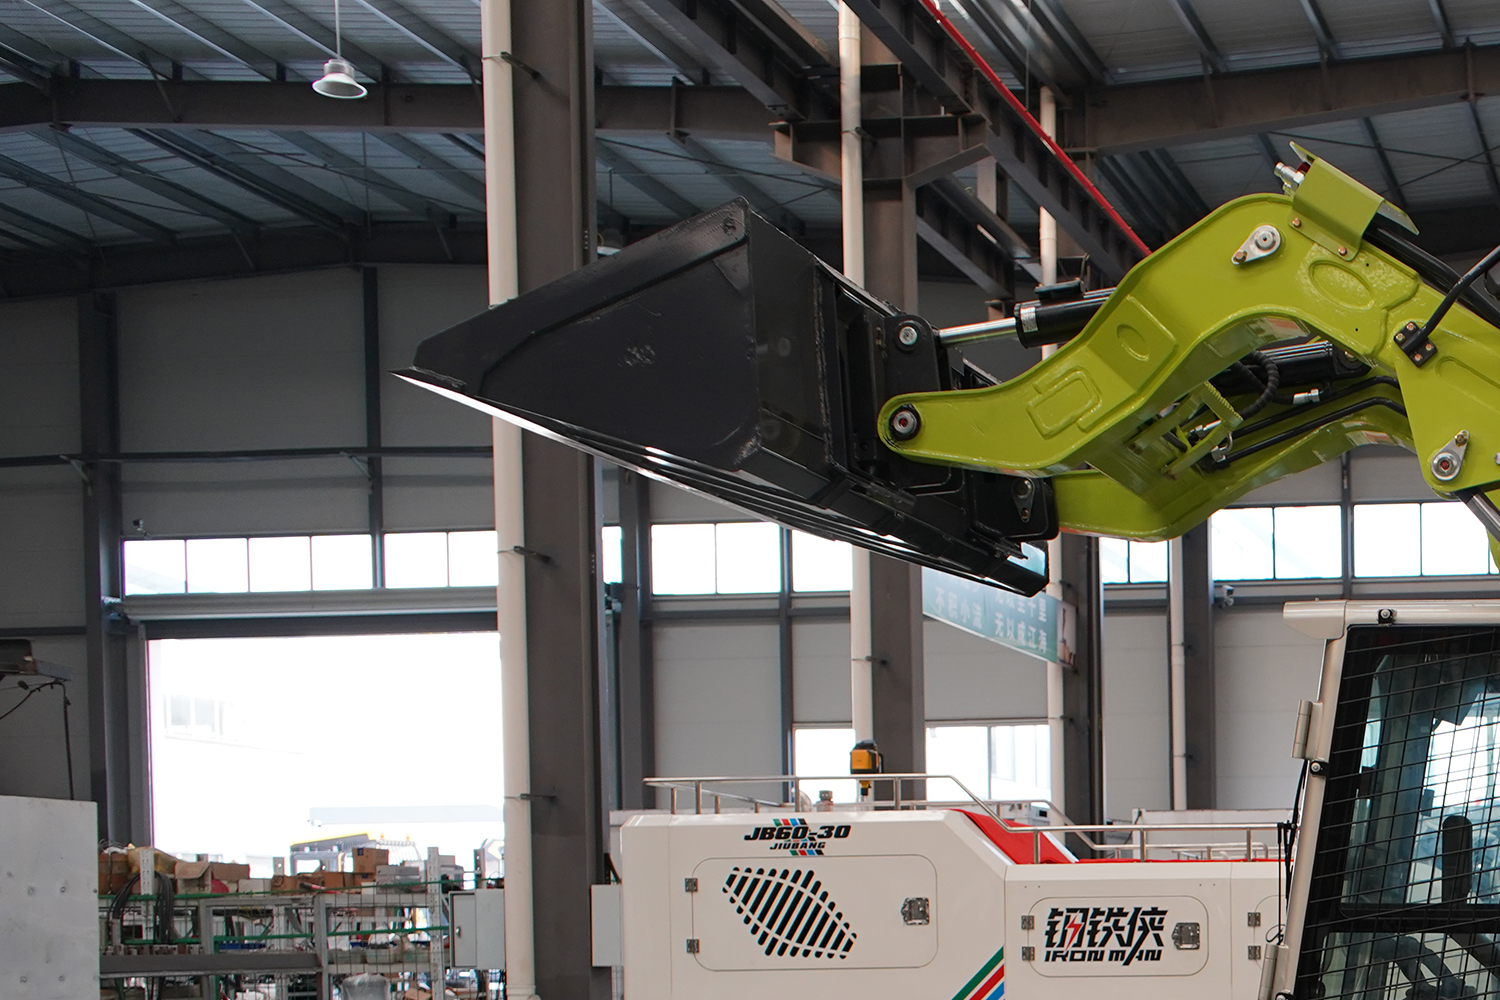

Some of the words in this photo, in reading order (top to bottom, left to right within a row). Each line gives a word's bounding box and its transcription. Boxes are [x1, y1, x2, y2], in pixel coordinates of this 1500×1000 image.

[743, 825, 852, 840] JB60-30
[769, 842, 826, 850] JIUBANG
[1044, 906, 1169, 950] 钢铁侠
[1044, 950, 1105, 962] IRON
